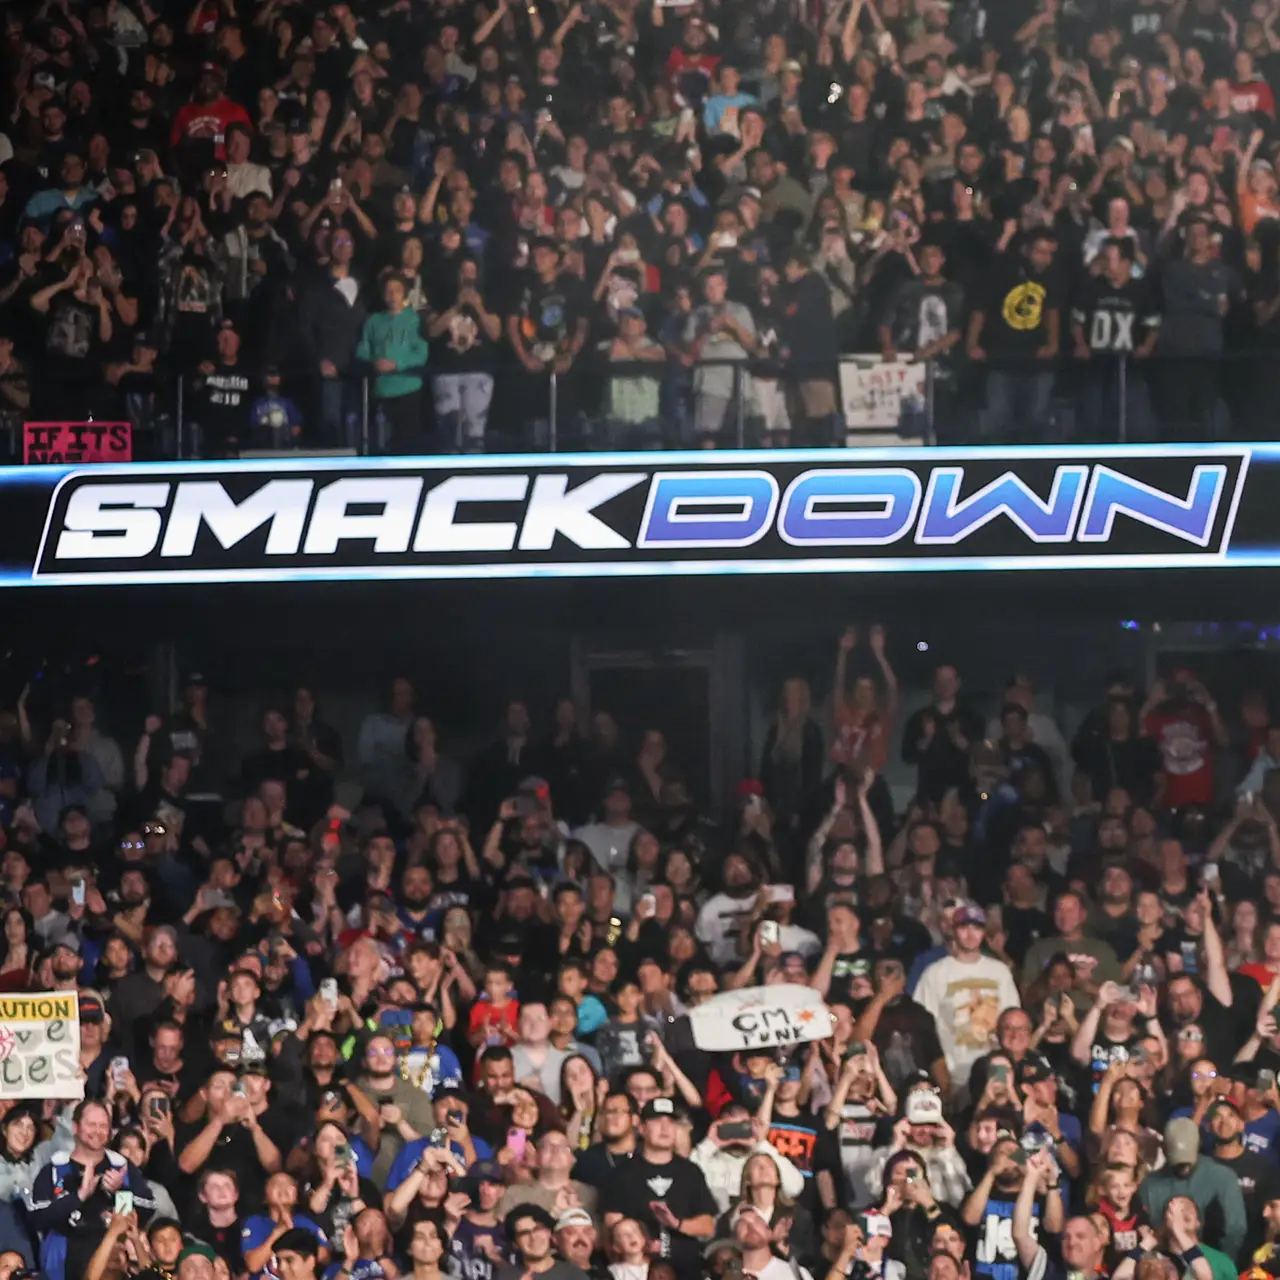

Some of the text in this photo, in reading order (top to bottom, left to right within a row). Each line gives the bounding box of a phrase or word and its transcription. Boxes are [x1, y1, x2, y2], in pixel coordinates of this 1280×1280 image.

[1091, 309, 1135, 351] DX
[28, 426, 129, 452] IF ITS
[733, 1007, 791, 1034] CM
